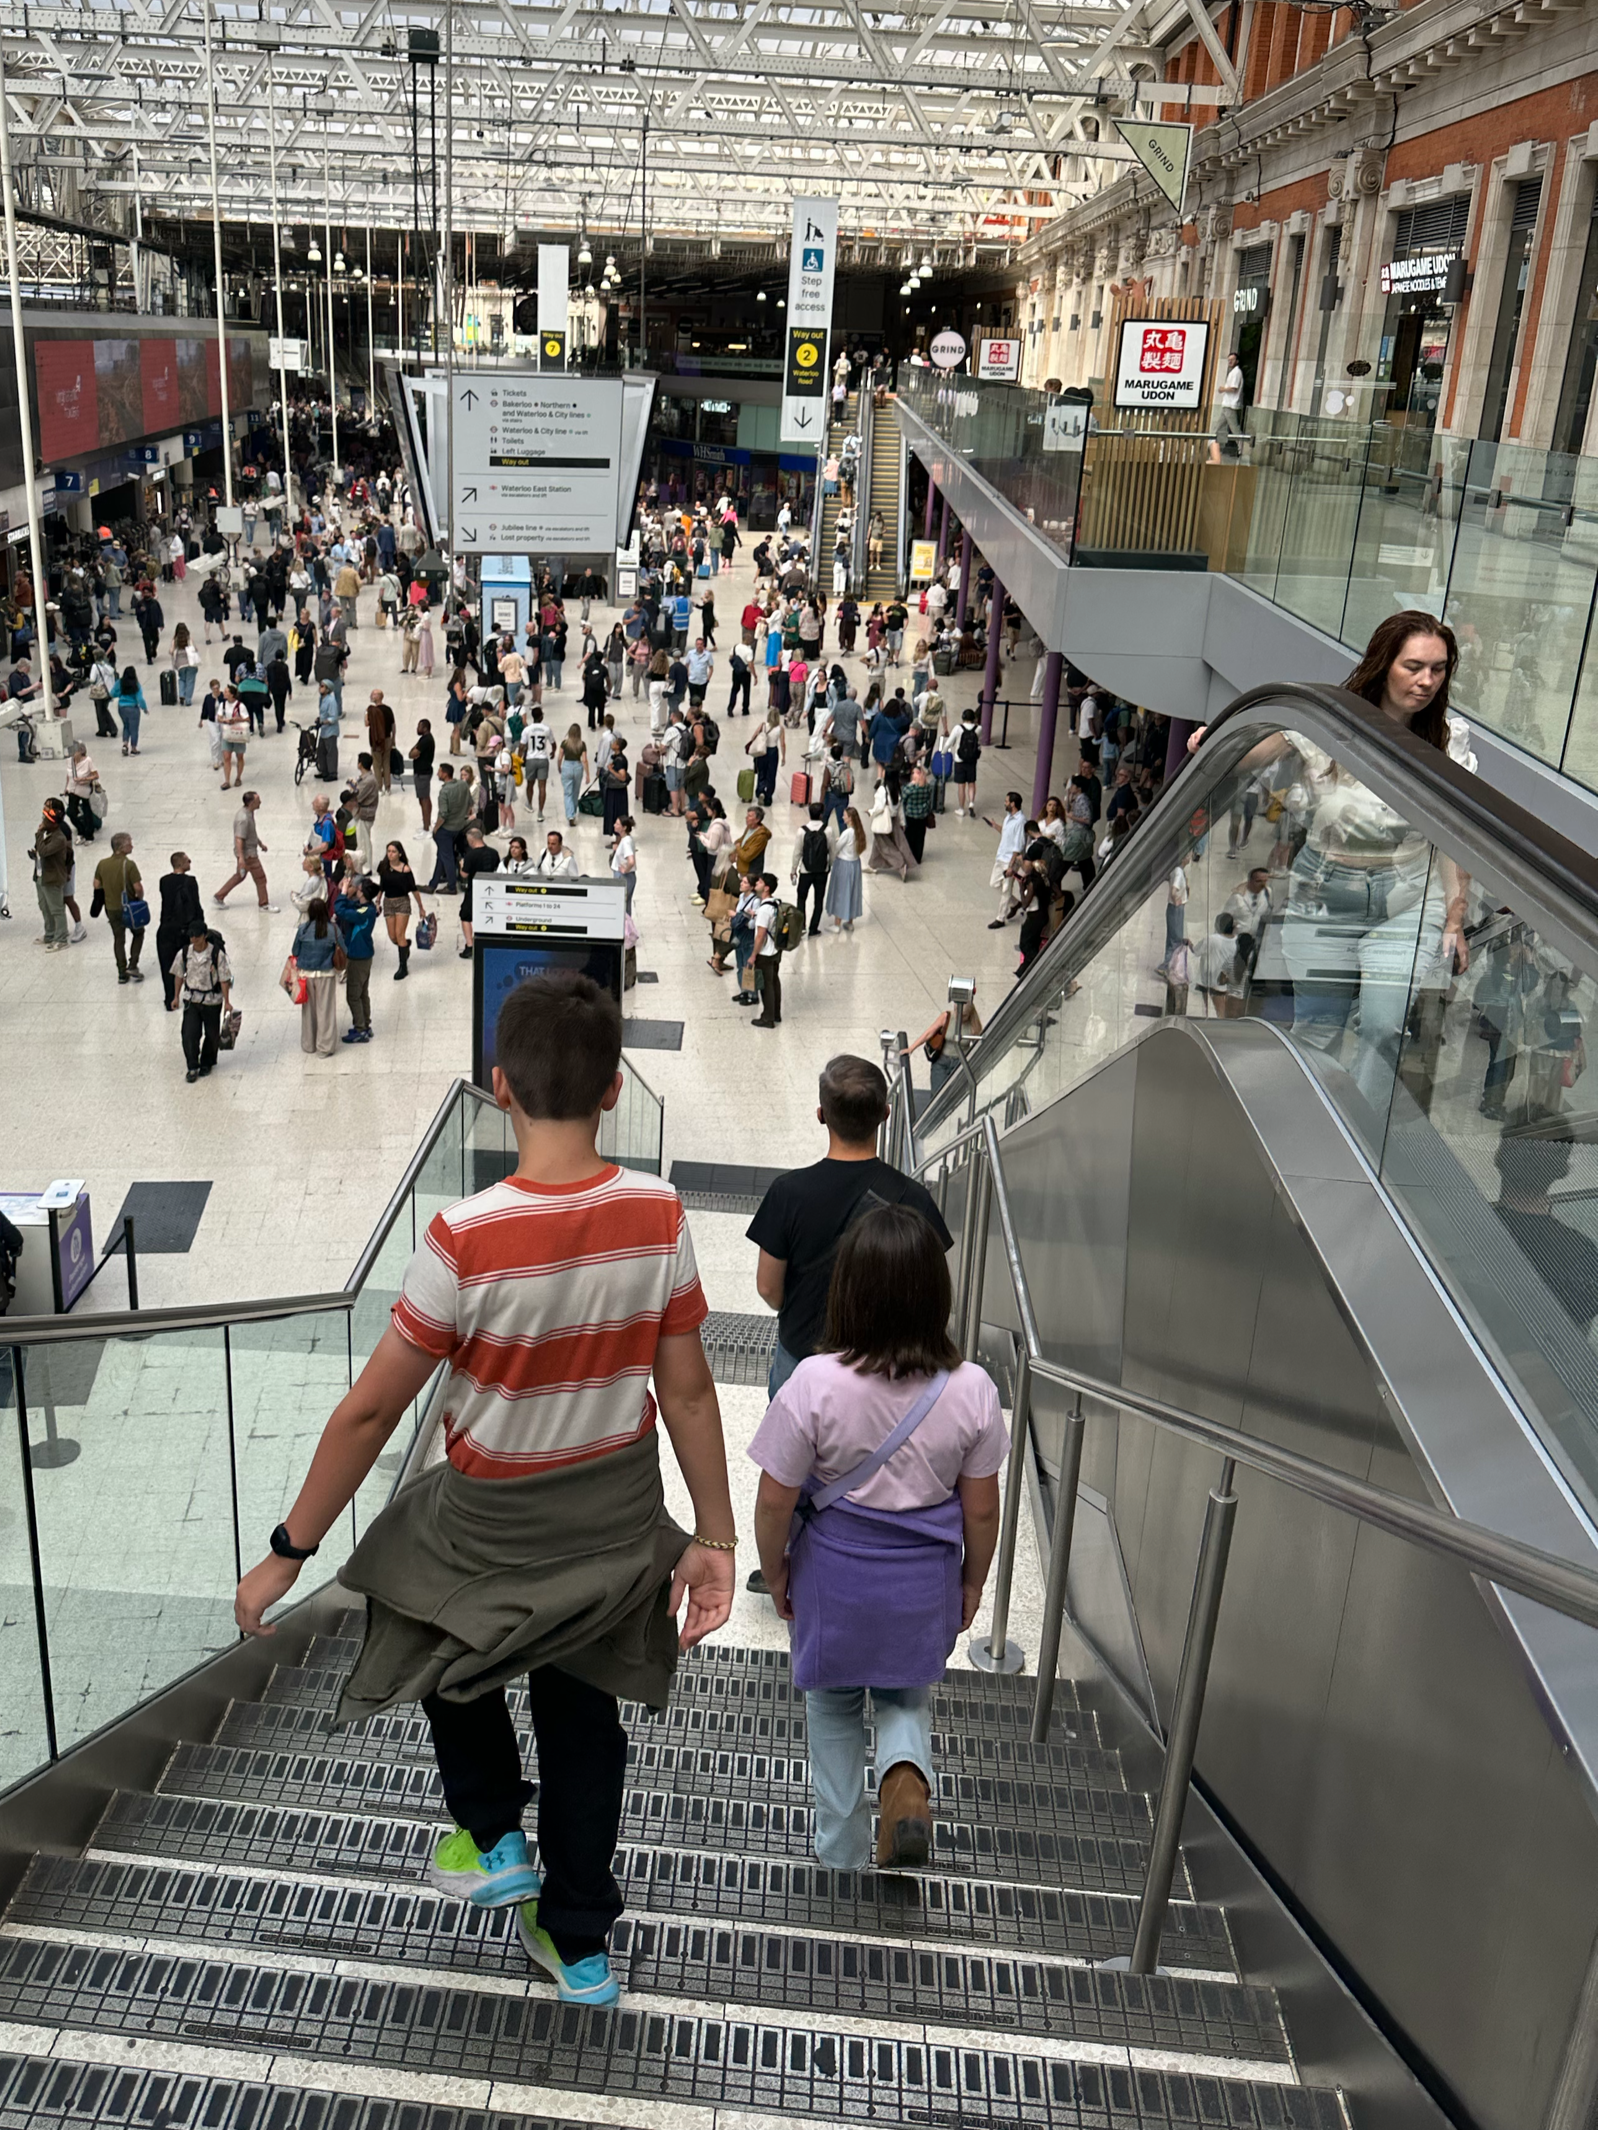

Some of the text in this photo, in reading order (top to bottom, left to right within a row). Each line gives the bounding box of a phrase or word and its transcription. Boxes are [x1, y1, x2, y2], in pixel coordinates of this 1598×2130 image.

[1148, 139, 1174, 172] GRIND
[1389, 256, 1432, 280] MARUGAME
[801, 276, 822, 287] Step
[801, 289, 820, 298] free
[1234, 288, 1258, 312] GRIND
[795, 303, 825, 311] access
[792, 330, 824, 340] Way out
[1143, 331, 1183, 350] 丸亀
[931, 345, 965, 355] GRIND
[803, 350, 811, 361] 2
[1124, 379, 1194, 391] MARUGAME
[502, 389, 527, 397] Tickets
[1141, 390, 1175, 400] UDON
[555, 411, 568, 419] City
[540, 428, 554, 436] City
[189, 435, 195, 444] 9
[502, 437, 524, 445] Toilets
[145, 450, 152, 459] 8
[517, 448, 546, 456] Luggage
[692, 445, 725, 461] WHSmith
[502, 458, 516, 466] Way
[65, 476, 73, 487] 7
[530, 736, 545, 751] 13
[519, 966, 545, 976] THAT
